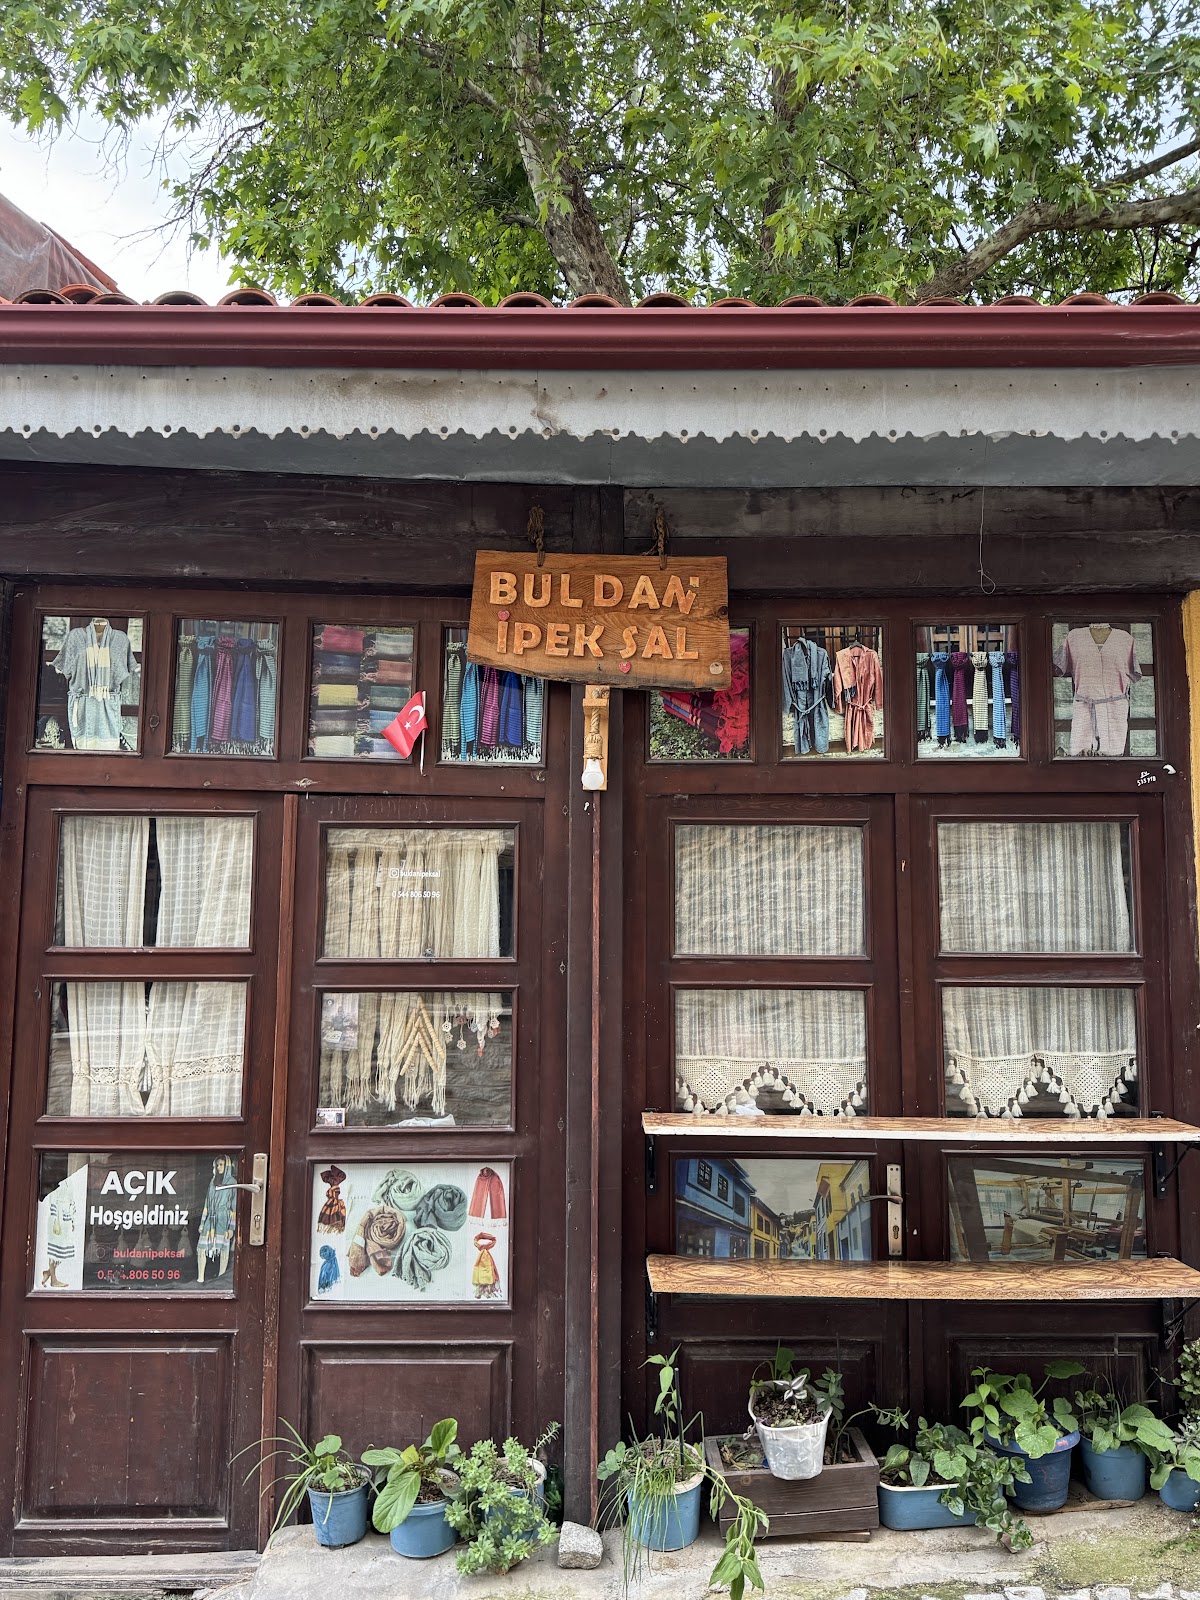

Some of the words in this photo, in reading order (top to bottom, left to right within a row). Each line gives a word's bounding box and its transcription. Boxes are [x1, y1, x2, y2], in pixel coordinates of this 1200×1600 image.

[497, 610, 604, 657] İPEK
[100, 1170, 177, 1201] AÇIK
[90, 1205, 188, 1230] Hoşgeldiniz
[113, 1247, 185, 1260] buldanipeksal
[151, 1270, 165, 1279] 50
[167, 1270, 181, 1279] 96
